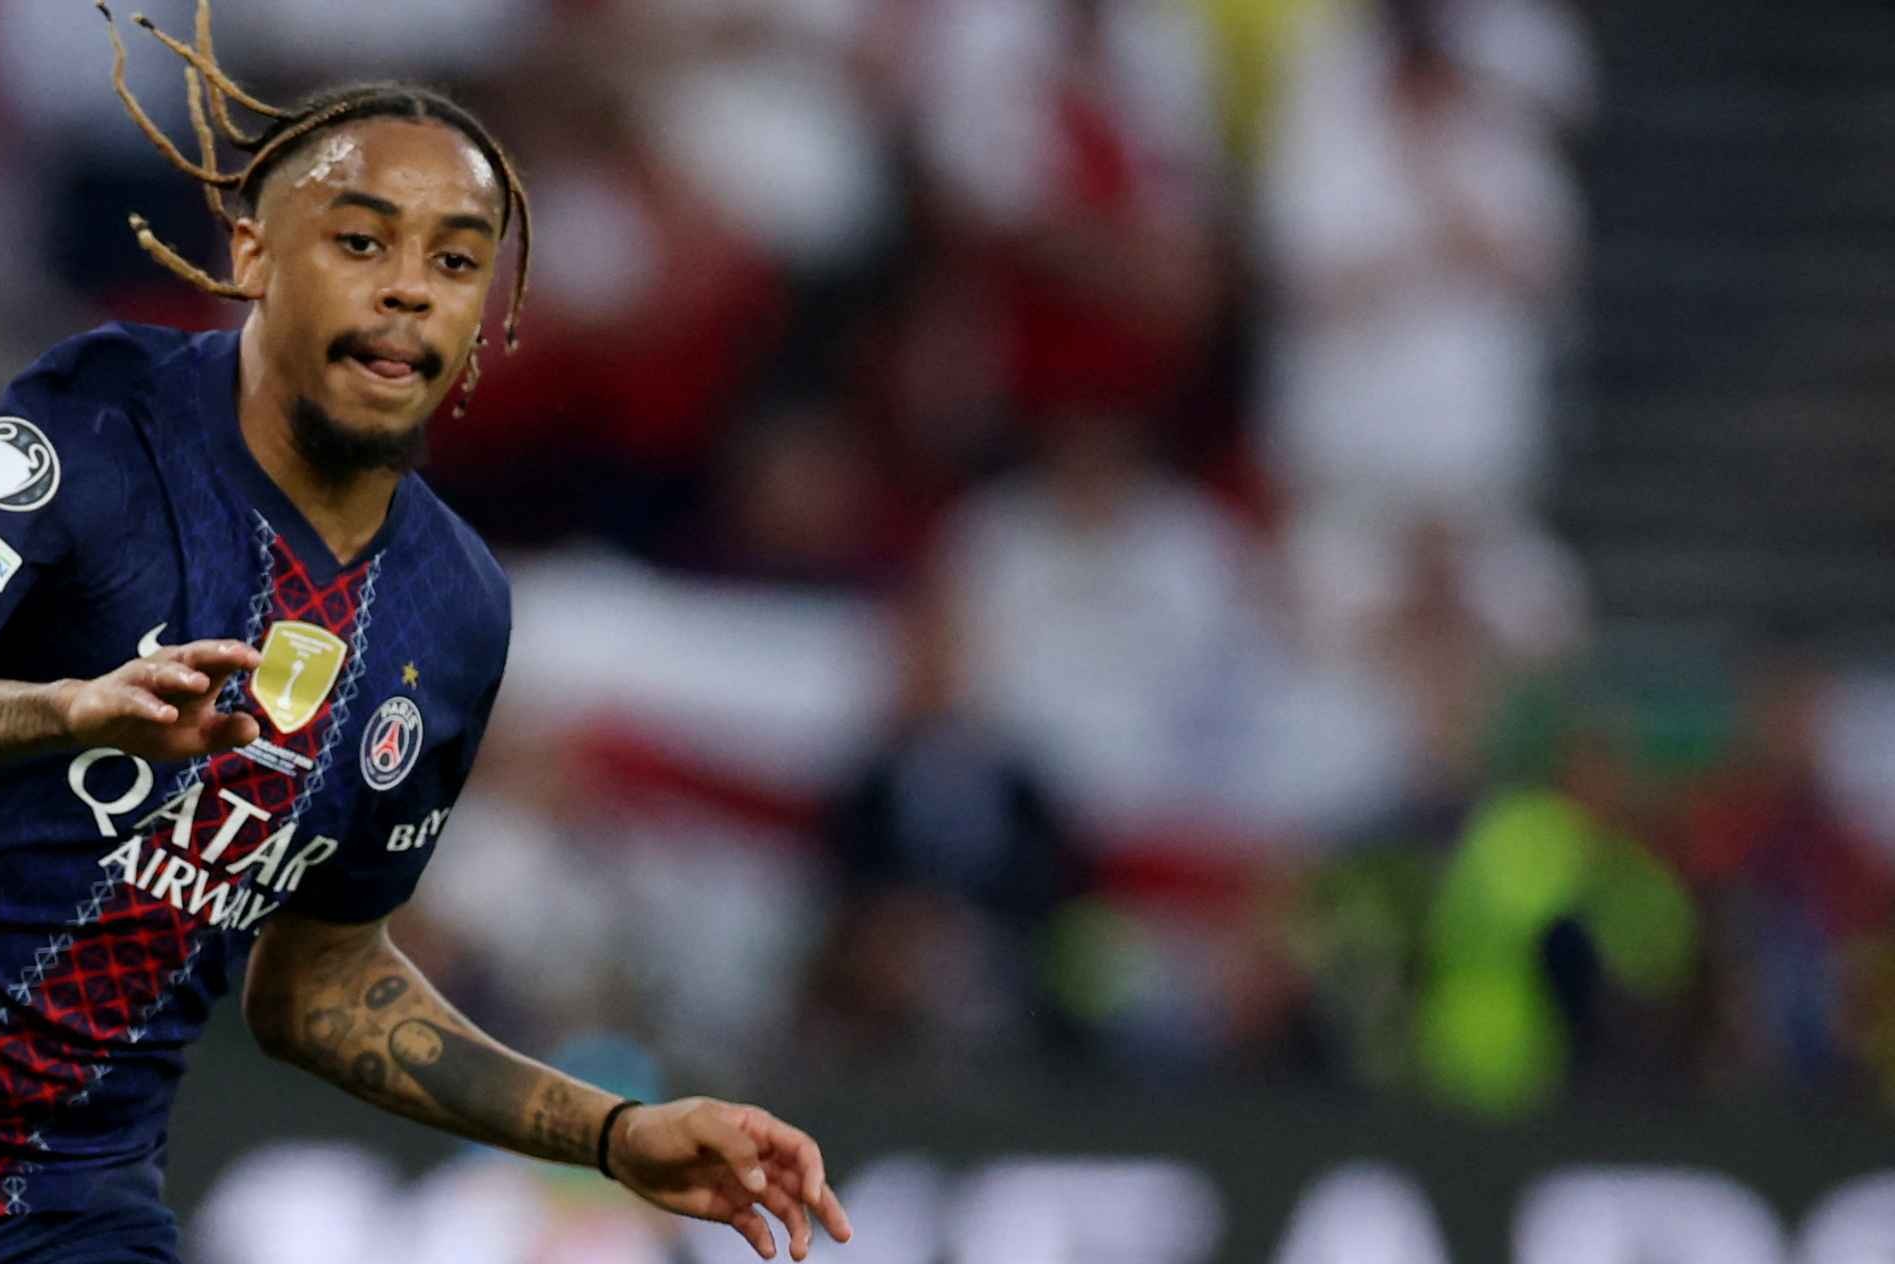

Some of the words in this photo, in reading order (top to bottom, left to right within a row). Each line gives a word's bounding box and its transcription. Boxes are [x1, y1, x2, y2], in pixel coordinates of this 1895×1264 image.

[379, 702, 419, 731] PARIS
[68, 747, 339, 893] QATAR
[97, 835, 280, 935] AIRWAY
